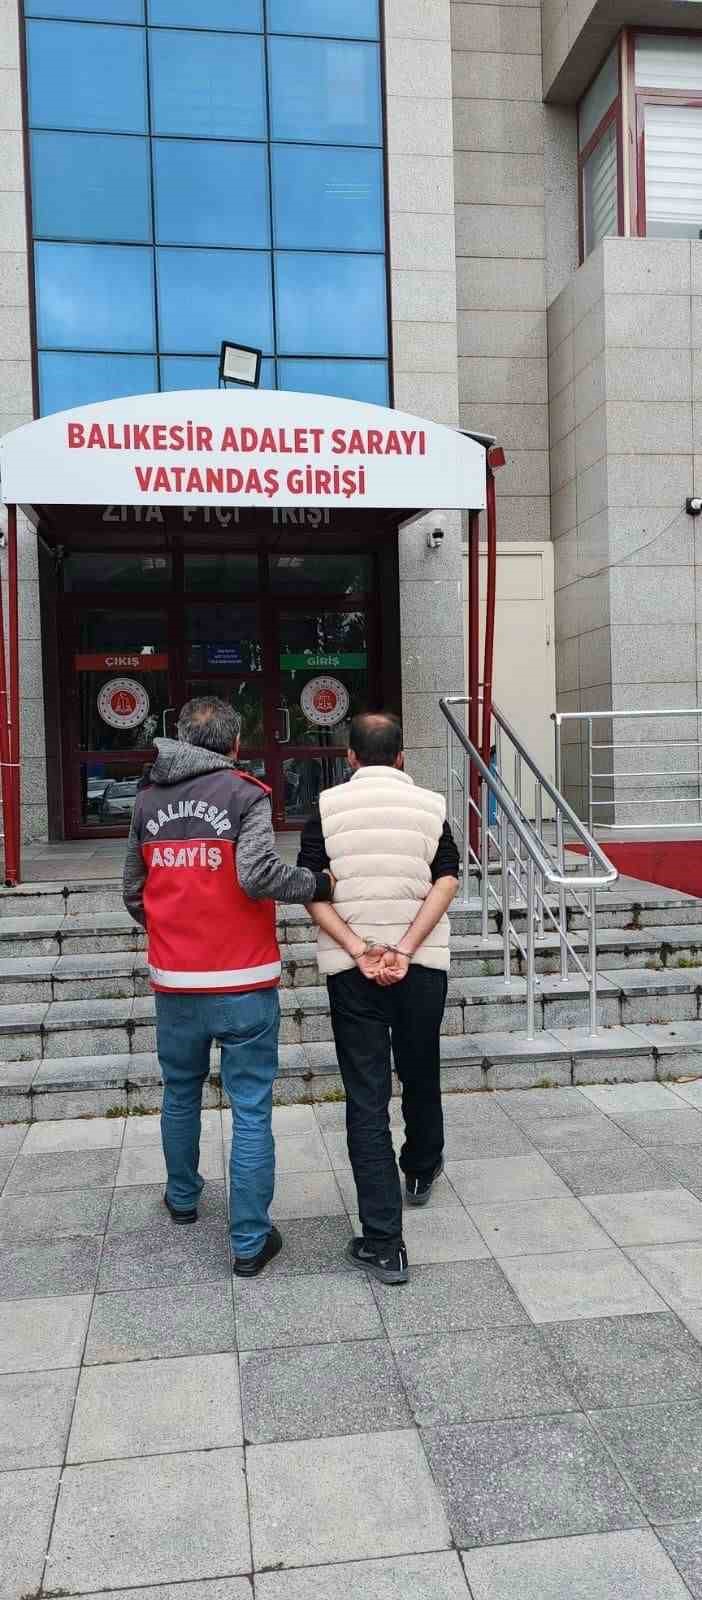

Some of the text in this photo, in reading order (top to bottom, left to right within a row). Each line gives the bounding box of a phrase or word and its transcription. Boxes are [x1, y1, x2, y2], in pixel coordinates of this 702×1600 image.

[67, 420, 426, 456] BALIKESİR ADALET SARAYI
[134, 464, 367, 499] VATANDAŞ GİRİŞİ
[104, 656, 140, 667] ÇIKIŞ
[306, 655, 340, 667] GİRİŞ
[146, 799, 232, 836] BALIKESİR
[151, 842, 223, 871] ASAYİŞ
